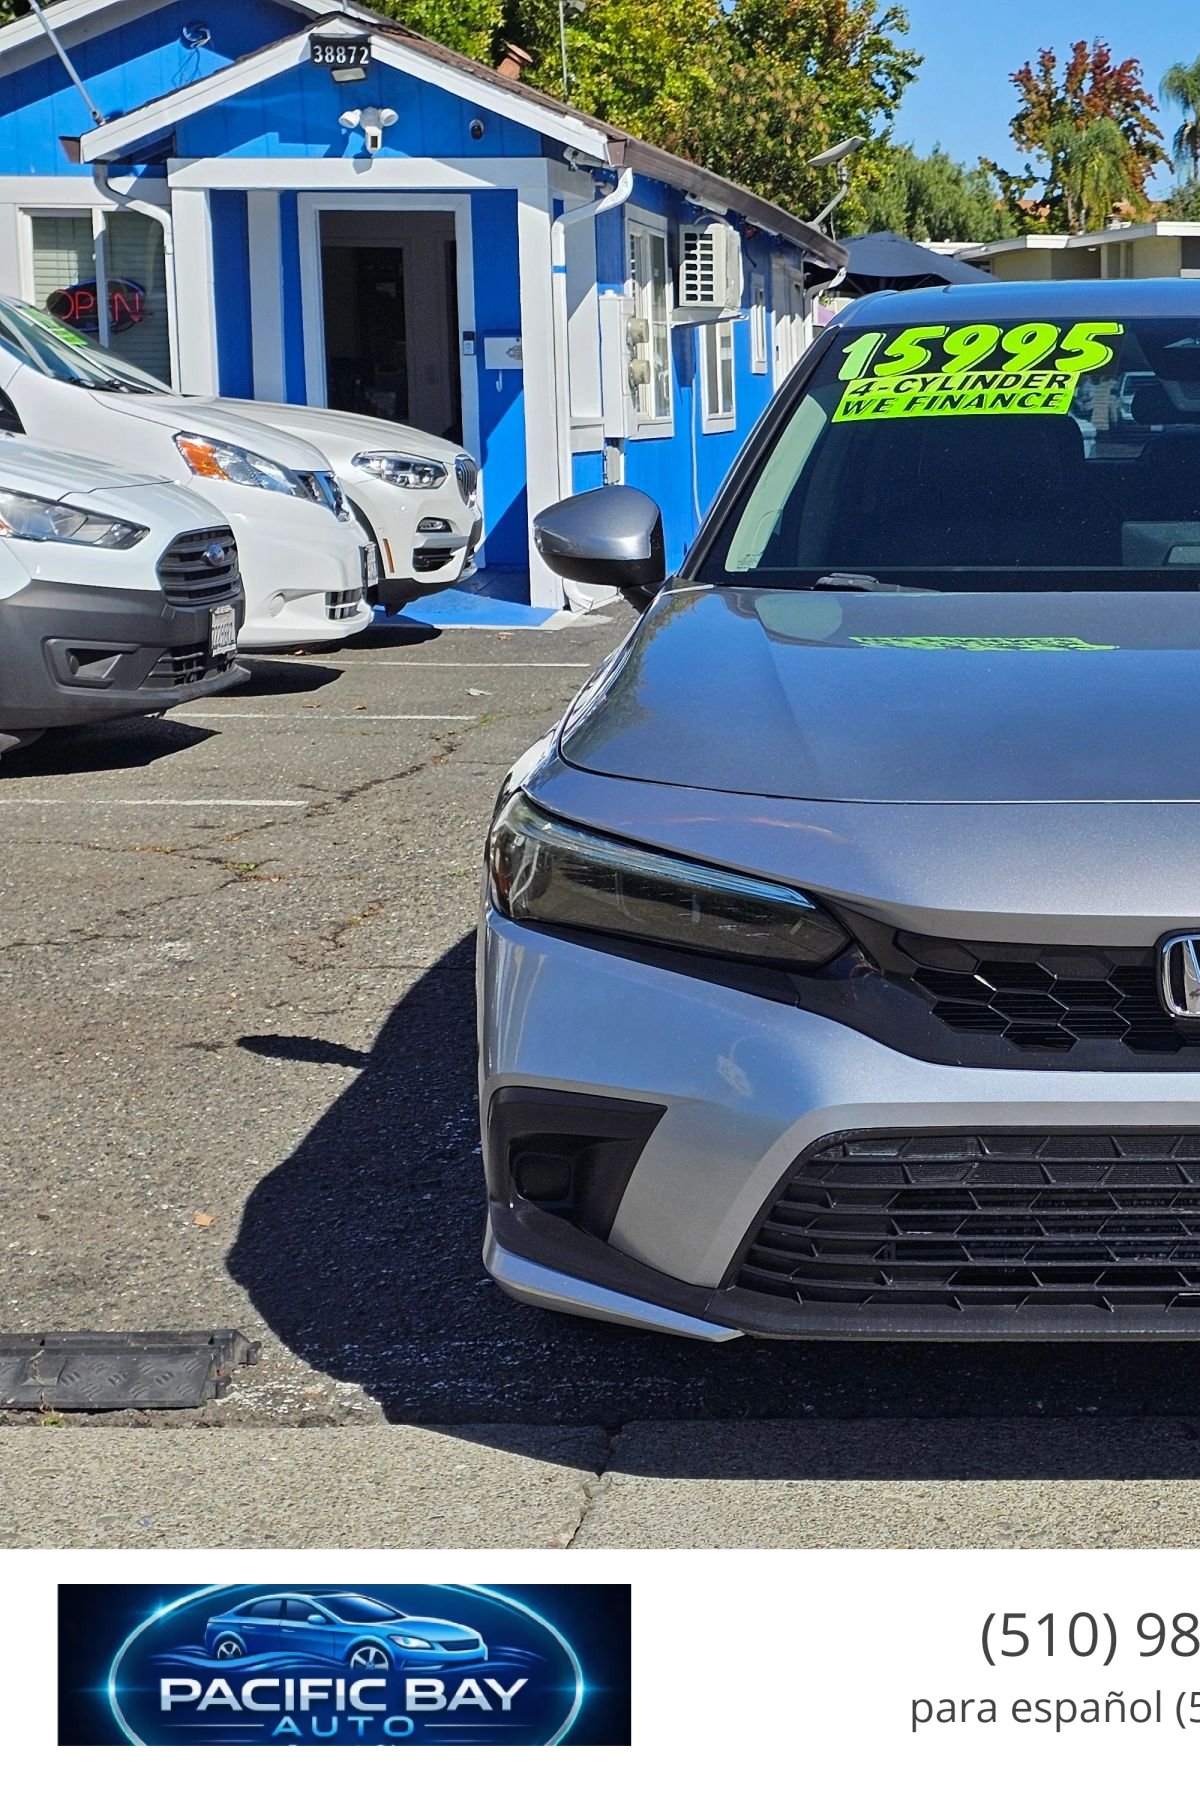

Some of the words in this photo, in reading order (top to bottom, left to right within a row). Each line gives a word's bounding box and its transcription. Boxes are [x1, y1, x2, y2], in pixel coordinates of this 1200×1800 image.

[312, 45, 370, 65] 38872
[47, 289, 143, 321] OPN
[838, 322, 1124, 380] 15995
[849, 373, 1072, 397] 4-CYLINDER
[842, 396, 895, 418] WE
[903, 392, 1067, 412] FINANCE
